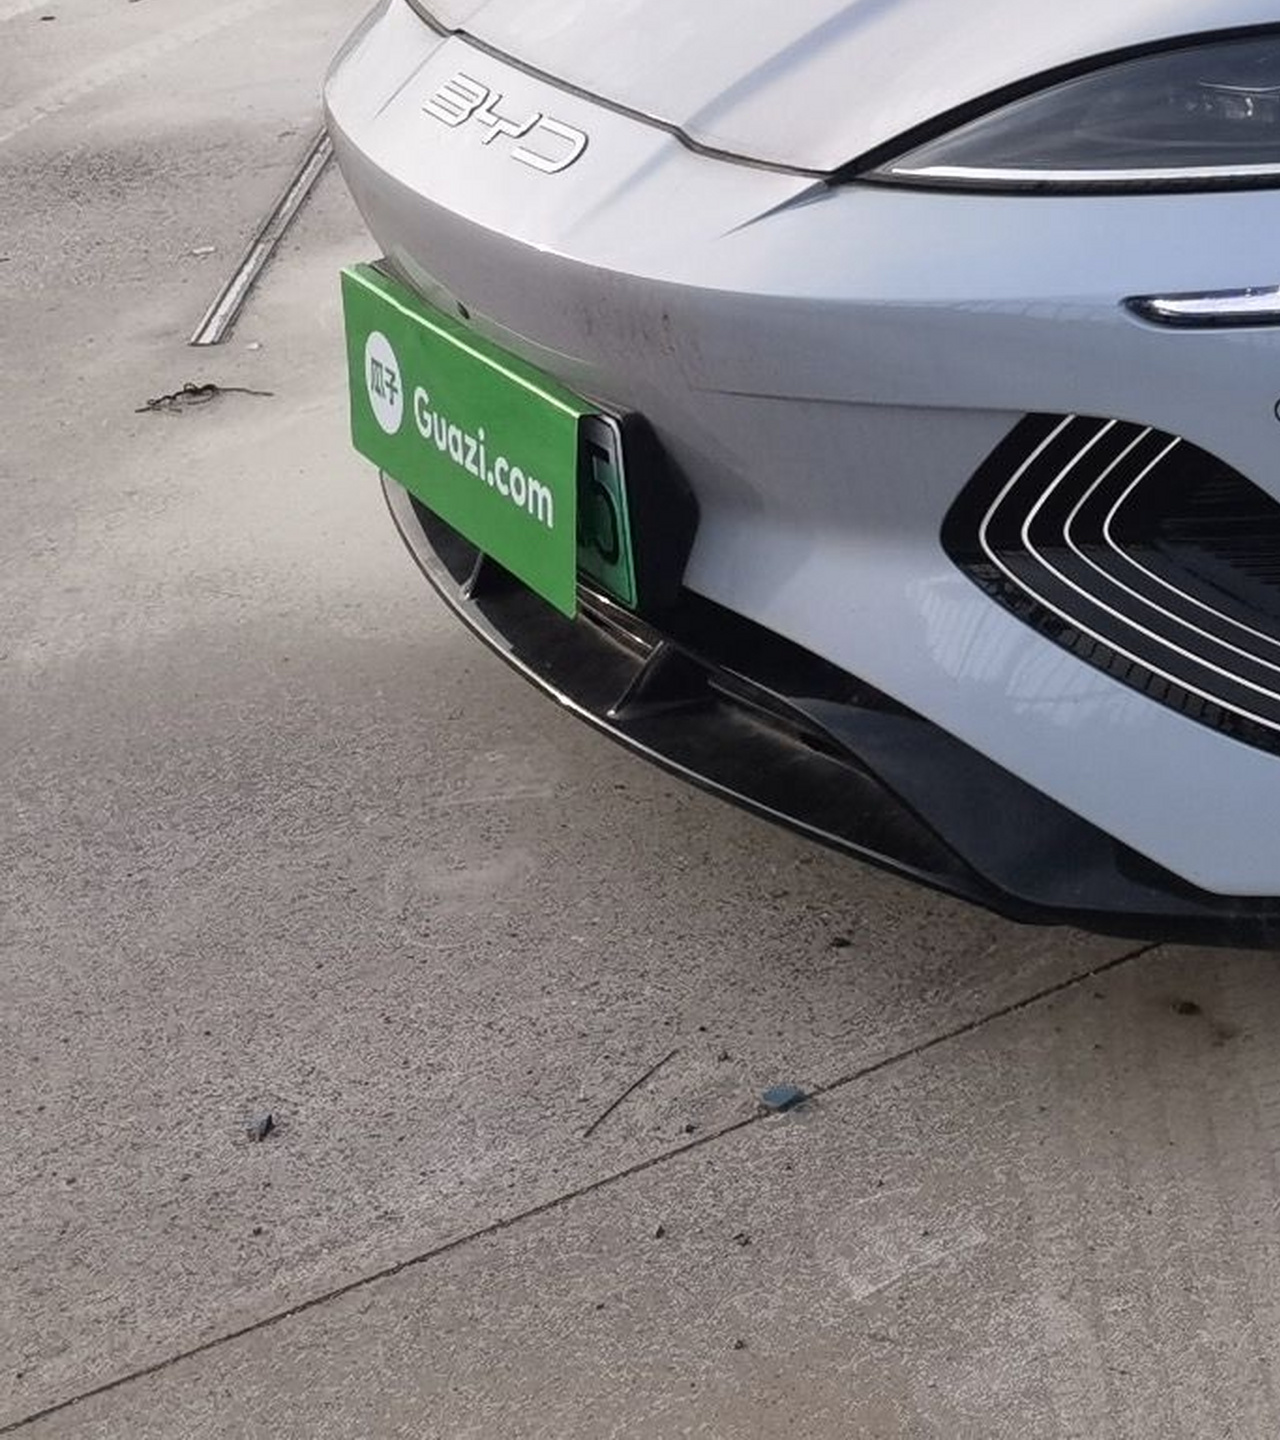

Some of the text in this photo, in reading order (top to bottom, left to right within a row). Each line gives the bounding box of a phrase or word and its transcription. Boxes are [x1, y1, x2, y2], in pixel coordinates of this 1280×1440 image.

[422, 72, 589, 175] BYD
[371, 357, 399, 406] 瓜子
[414, 386, 554, 529] Guazi.com
